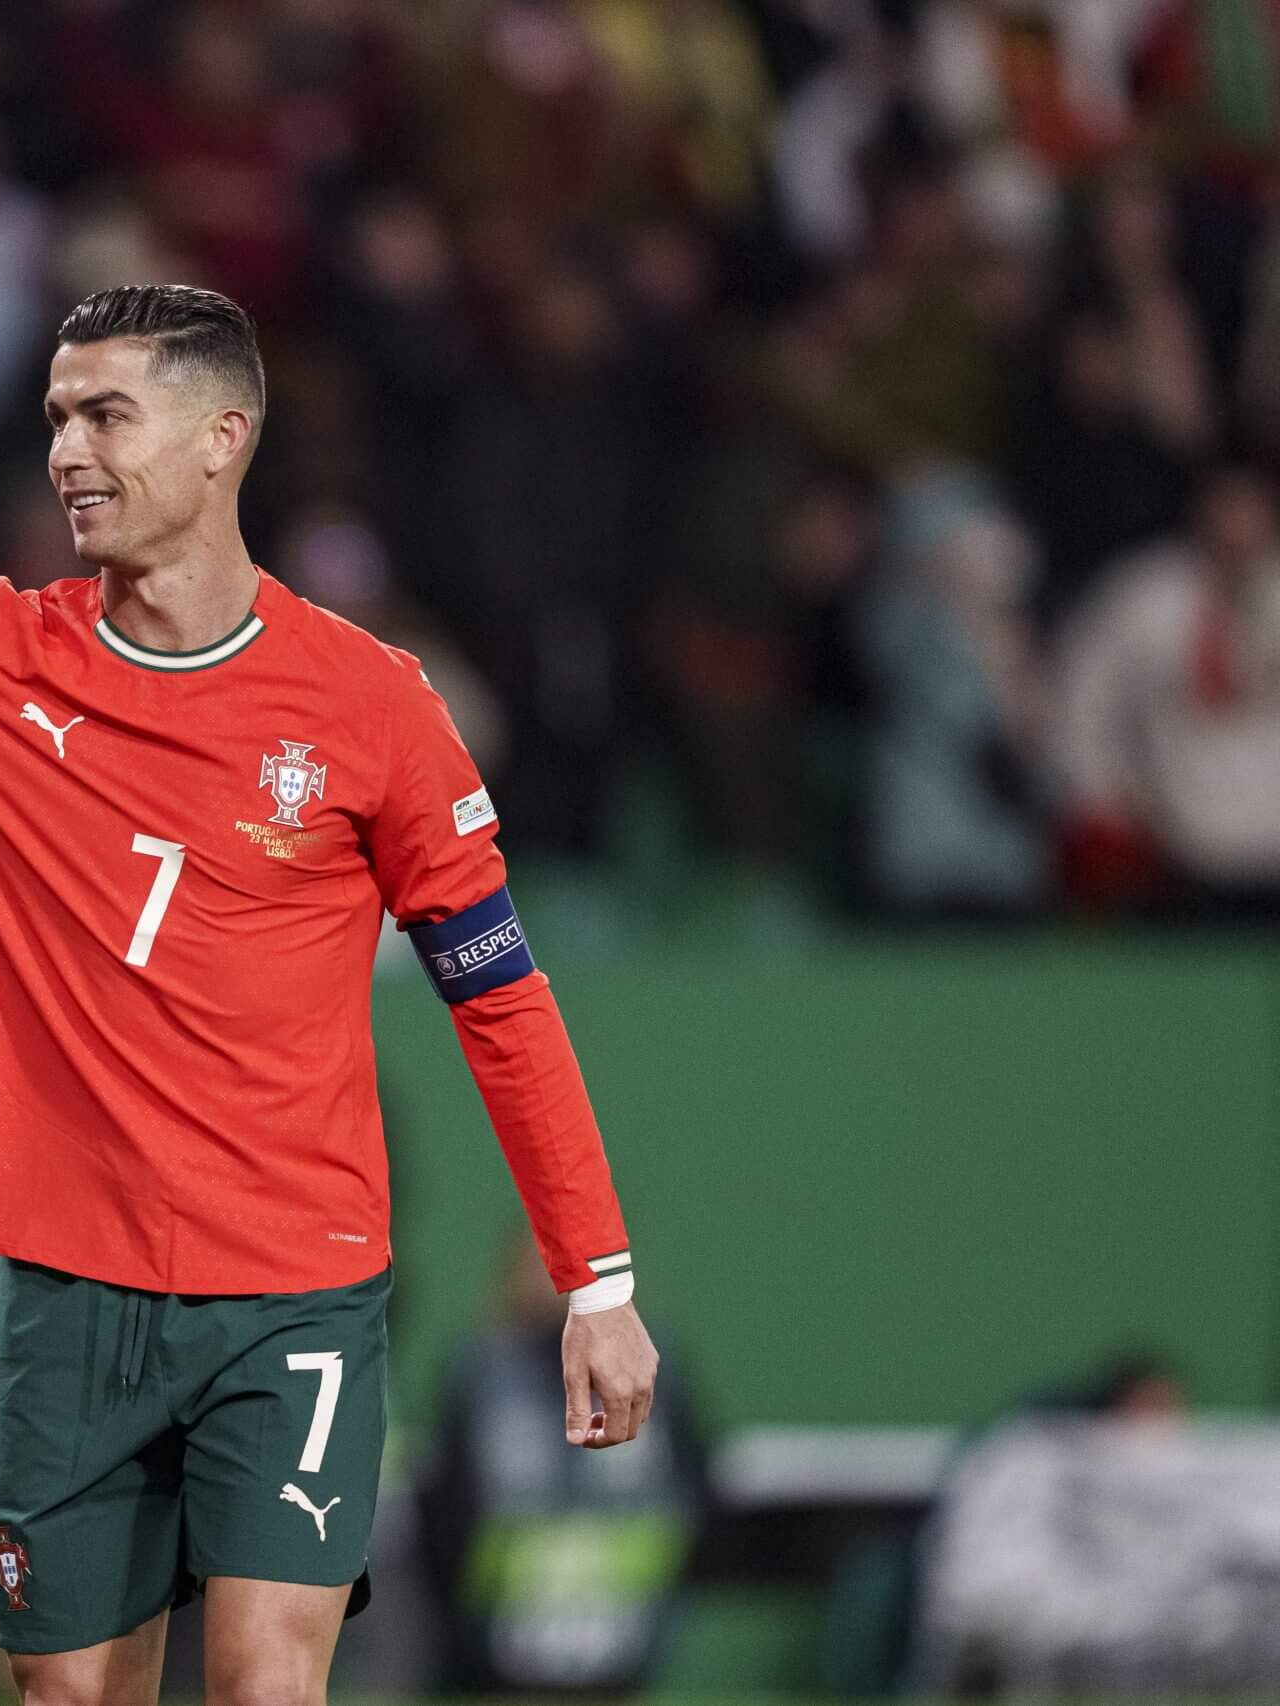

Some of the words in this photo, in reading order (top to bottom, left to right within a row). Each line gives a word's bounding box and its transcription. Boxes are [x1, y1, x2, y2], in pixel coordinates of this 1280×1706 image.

[249, 833, 261, 844] 23
[125, 833, 186, 968] 7
[458, 921, 522, 968] RESPECT
[286, 1351, 344, 1473] 7
